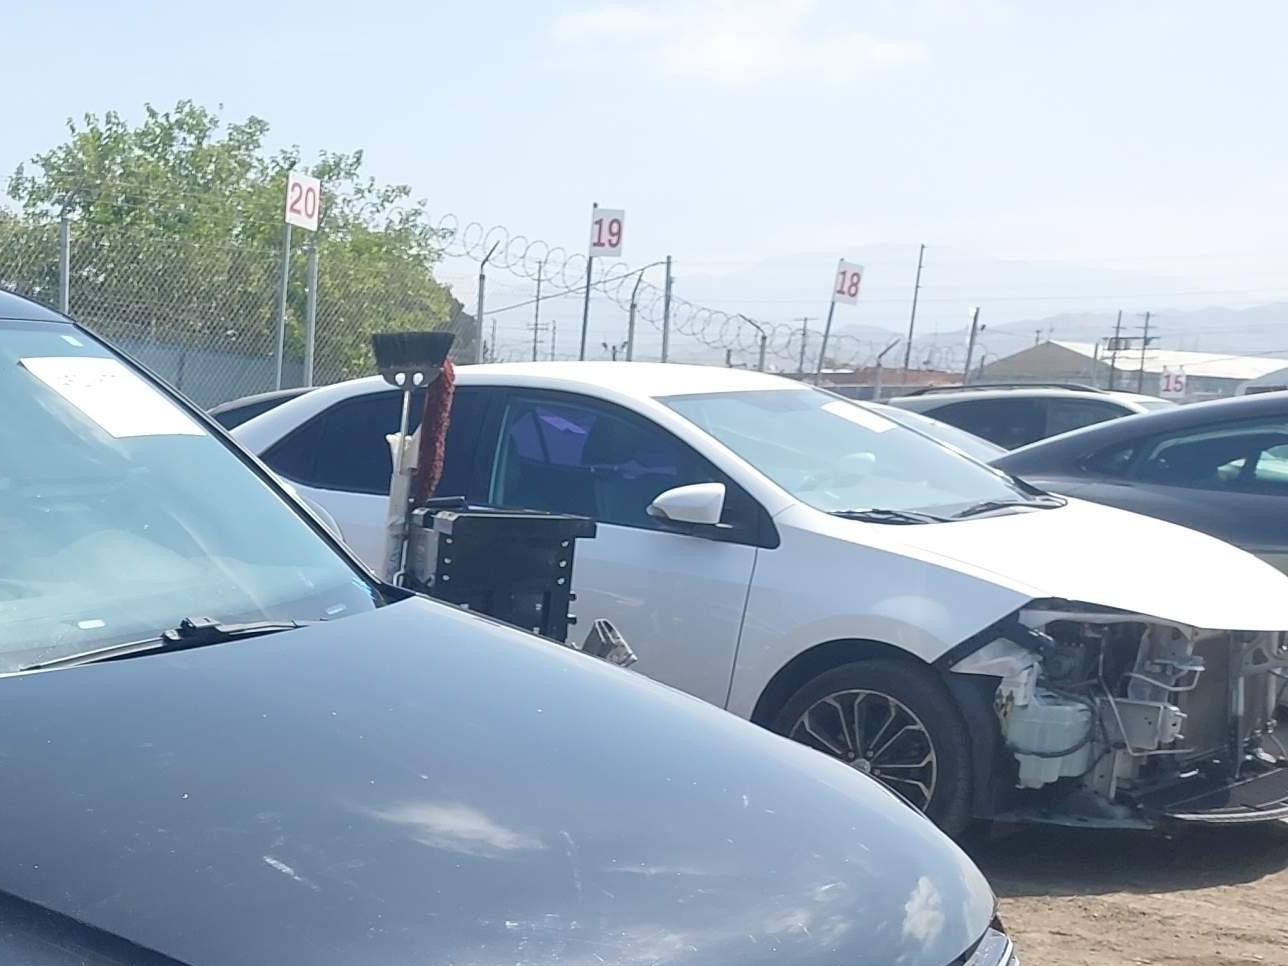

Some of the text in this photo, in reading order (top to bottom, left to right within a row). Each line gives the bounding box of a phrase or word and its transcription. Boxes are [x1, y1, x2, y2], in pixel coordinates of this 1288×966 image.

[289, 182, 316, 219] 20
[592, 217, 622, 248] 19
[836, 270, 861, 298] 18
[1162, 374, 1184, 393] 15
